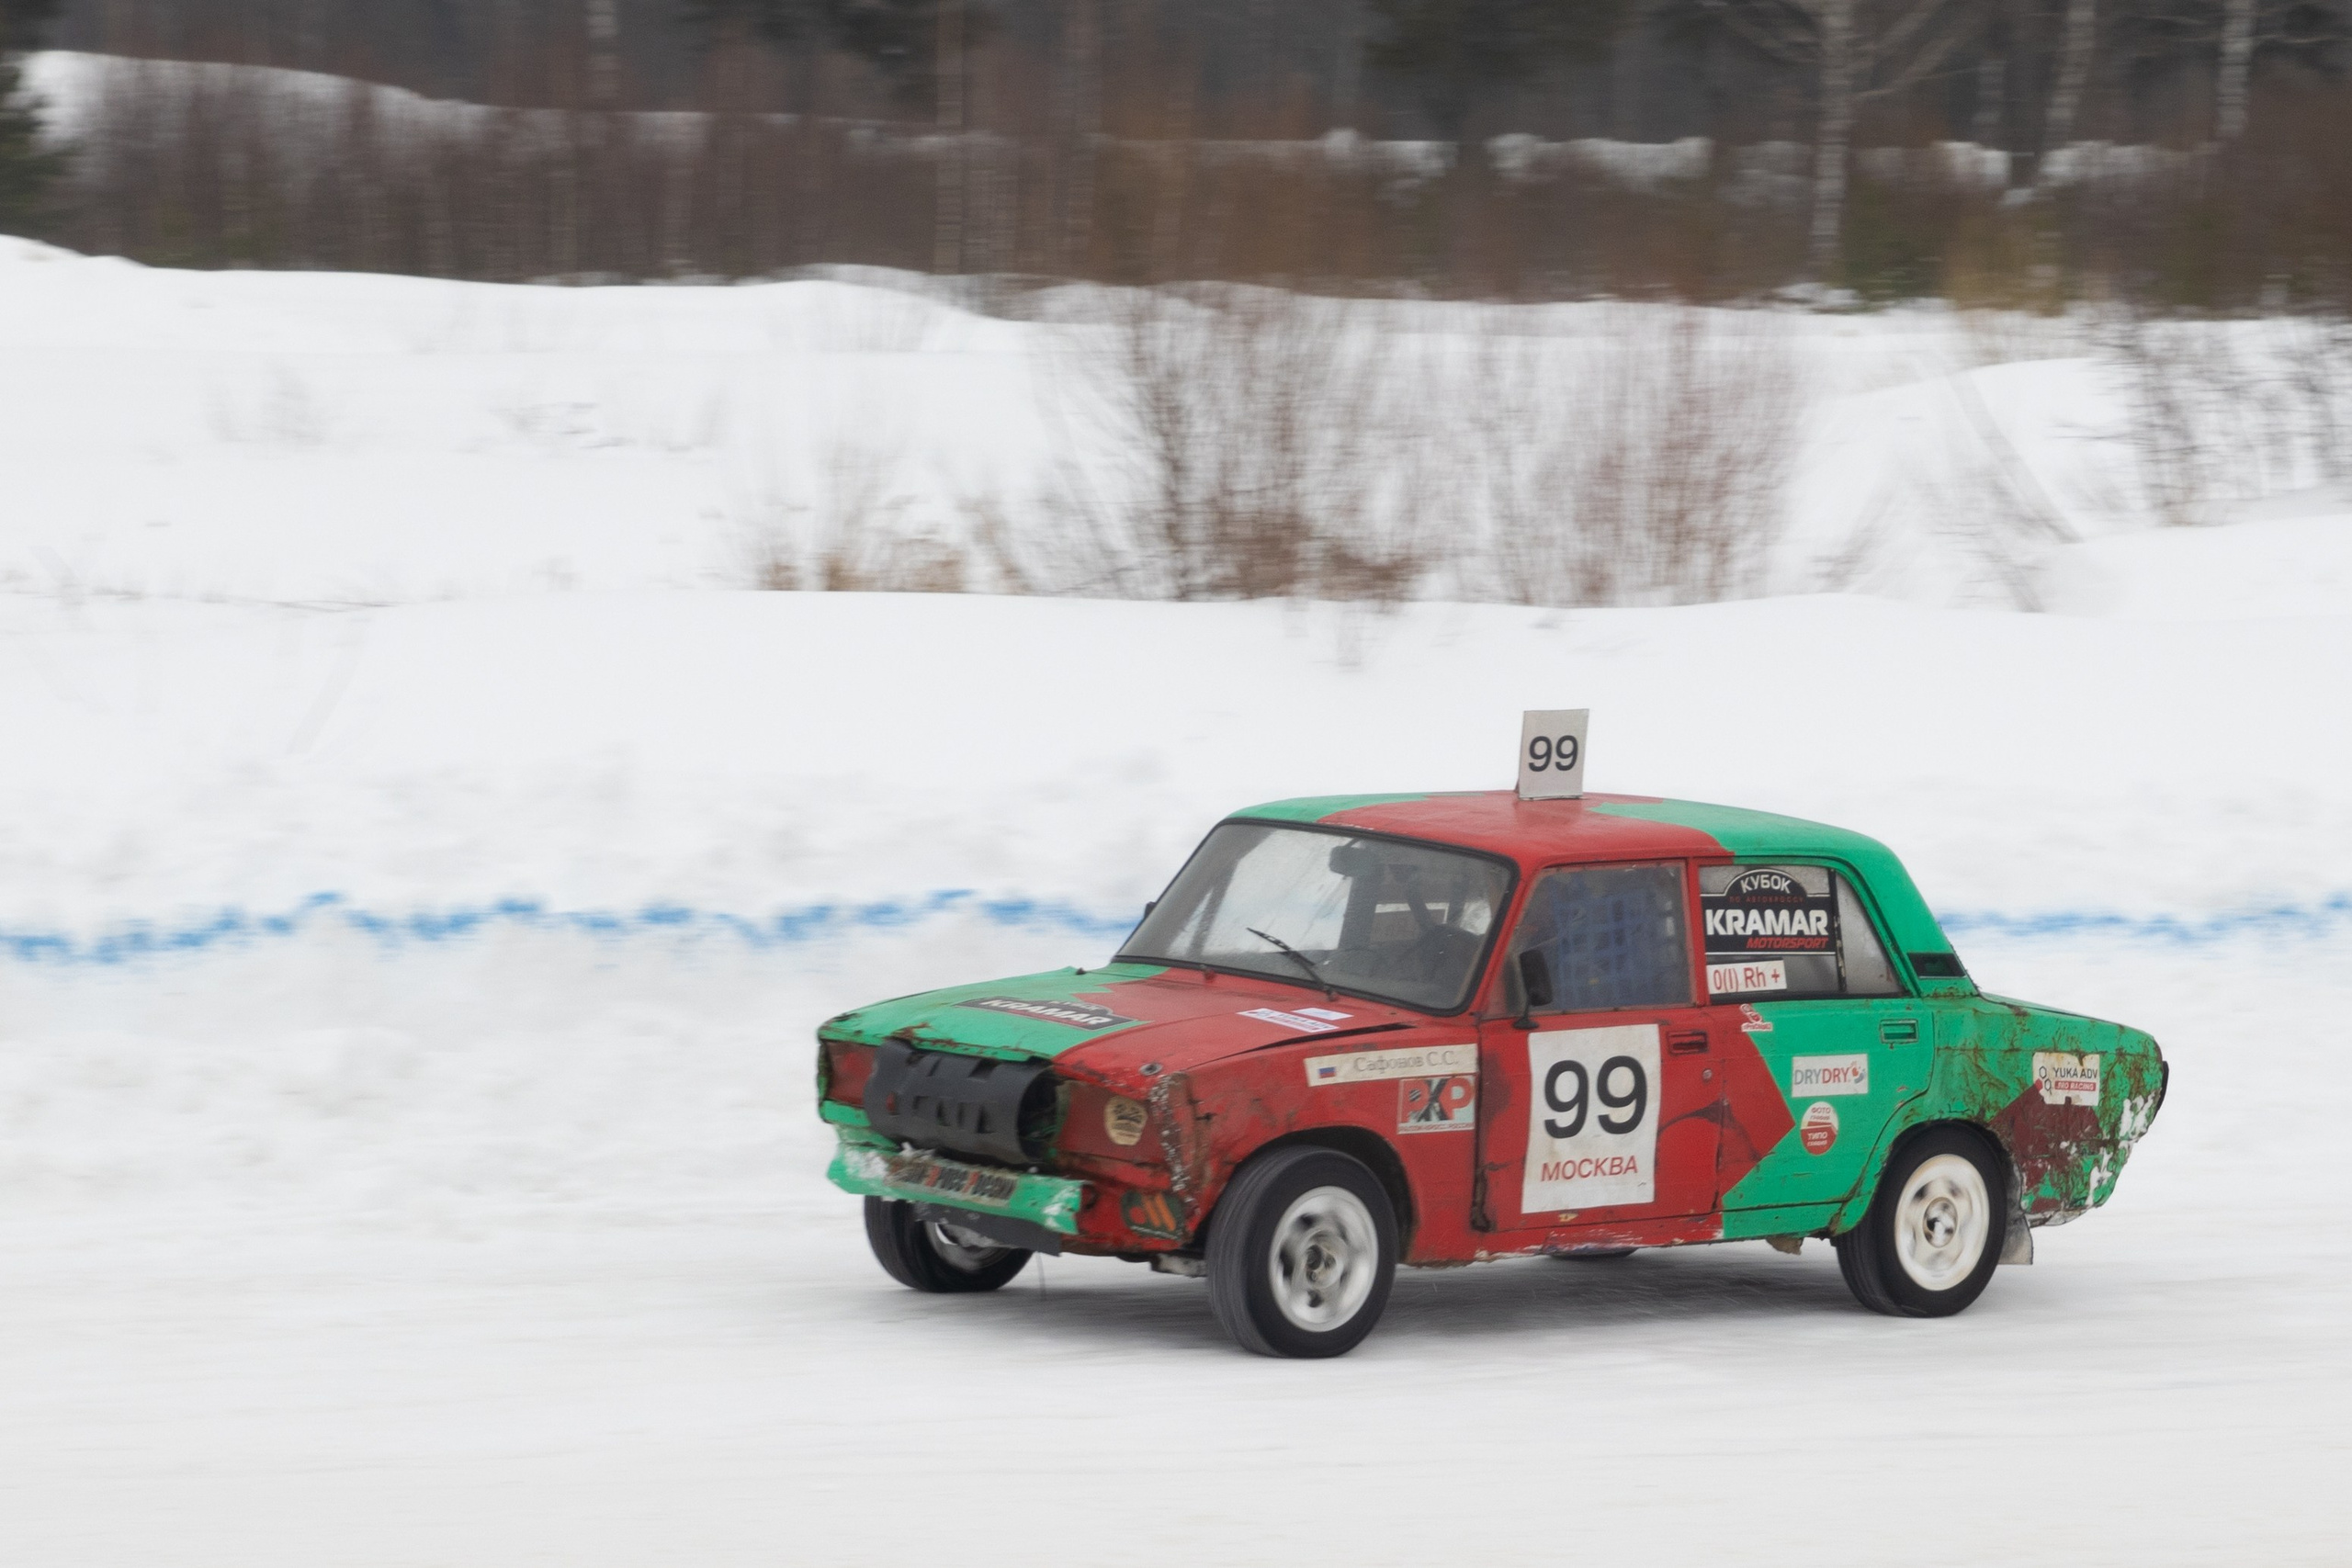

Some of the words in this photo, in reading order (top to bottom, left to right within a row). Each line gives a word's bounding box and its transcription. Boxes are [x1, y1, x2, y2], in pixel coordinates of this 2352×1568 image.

[1528, 735, 1578, 772] 99
[1740, 874, 1791, 894] КУБОК
[1705, 908, 1829, 936] KRAMAR
[1746, 937, 1829, 949] MOTORSPORT
[1743, 966, 1766, 988] Rh
[979, 998, 1114, 1025] KRAMAR
[1793, 1067, 1850, 1085] DRYDRY
[2052, 1066, 2078, 1078] YUKA
[2080, 1067, 2098, 1079] ADV
[1544, 1055, 1648, 1139] 99
[1541, 1155, 1638, 1182] МОСКВА
